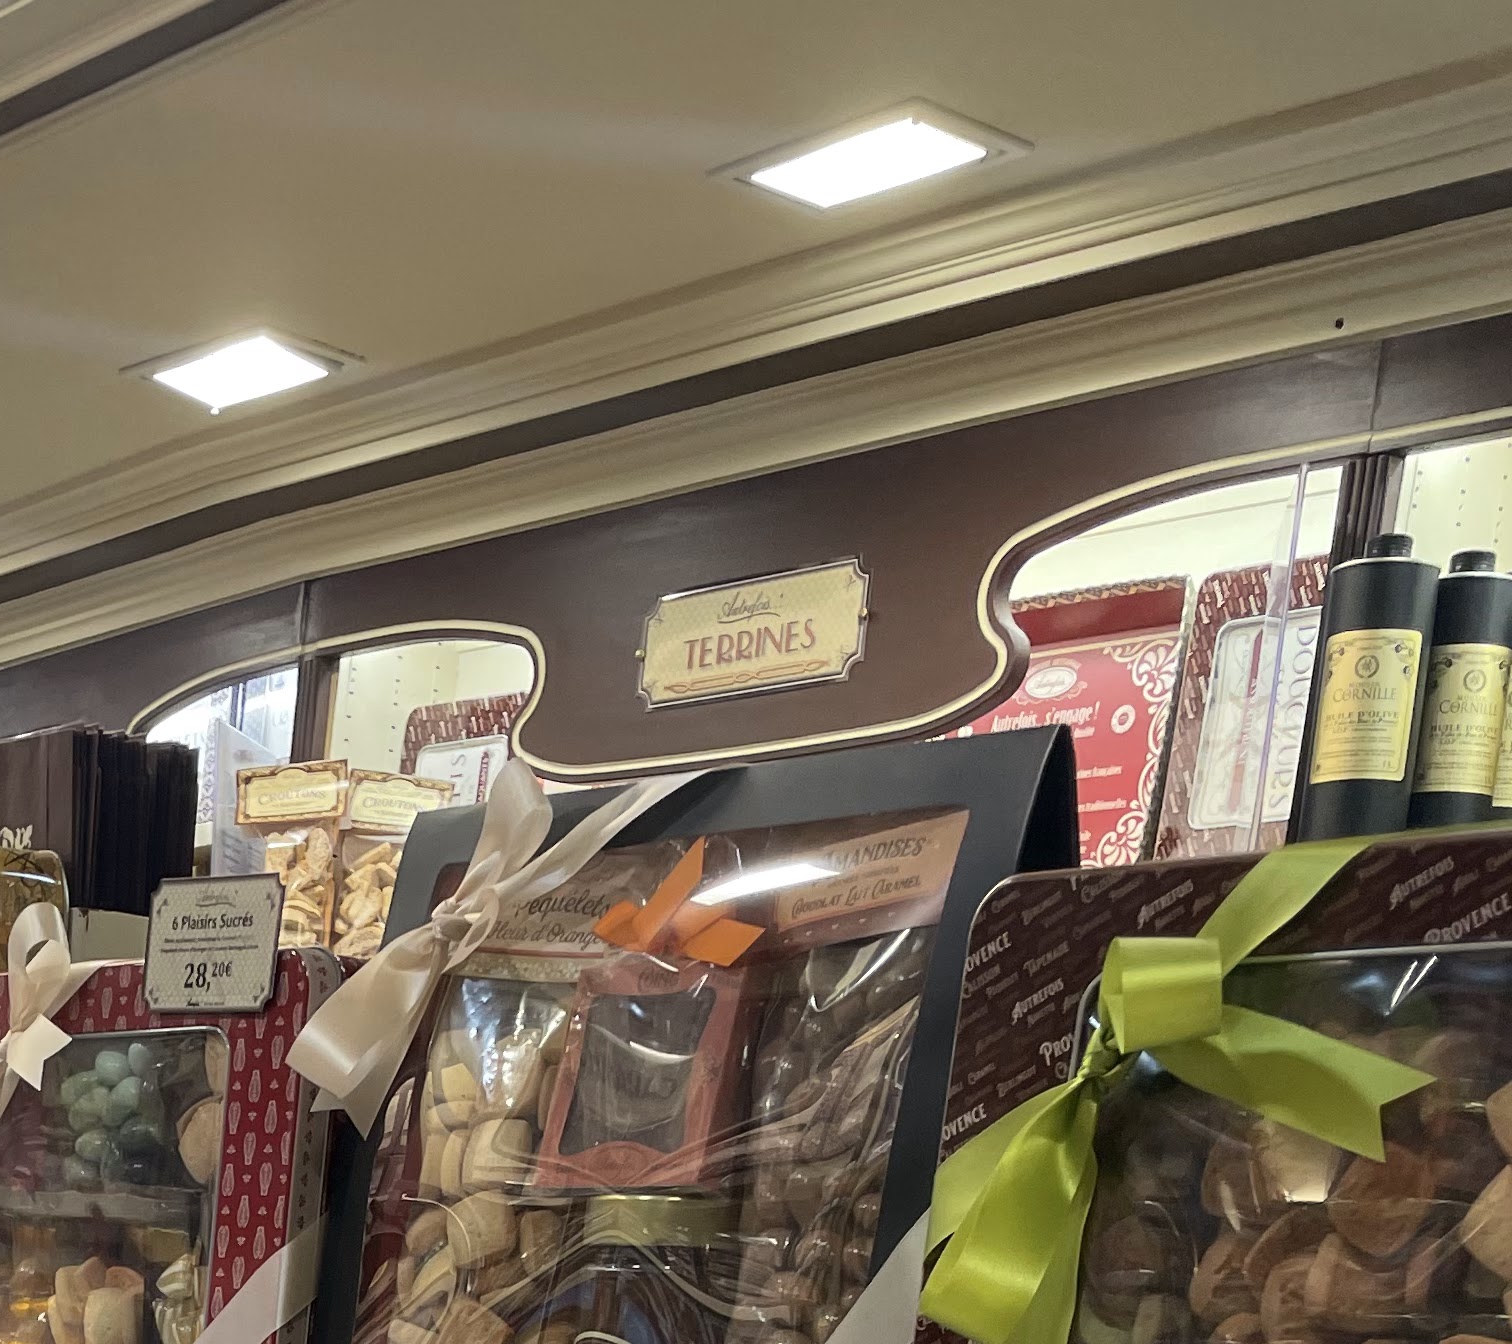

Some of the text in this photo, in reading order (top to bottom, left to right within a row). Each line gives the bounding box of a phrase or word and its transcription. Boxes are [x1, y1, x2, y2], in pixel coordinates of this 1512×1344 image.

[684, 618, 818, 671] TERRINES
[1333, 687, 1397, 703] CORNILLE
[872, 875, 921, 899] CARAMEL
[172, 911, 254, 931] 6 Plaisirs Sucrés
